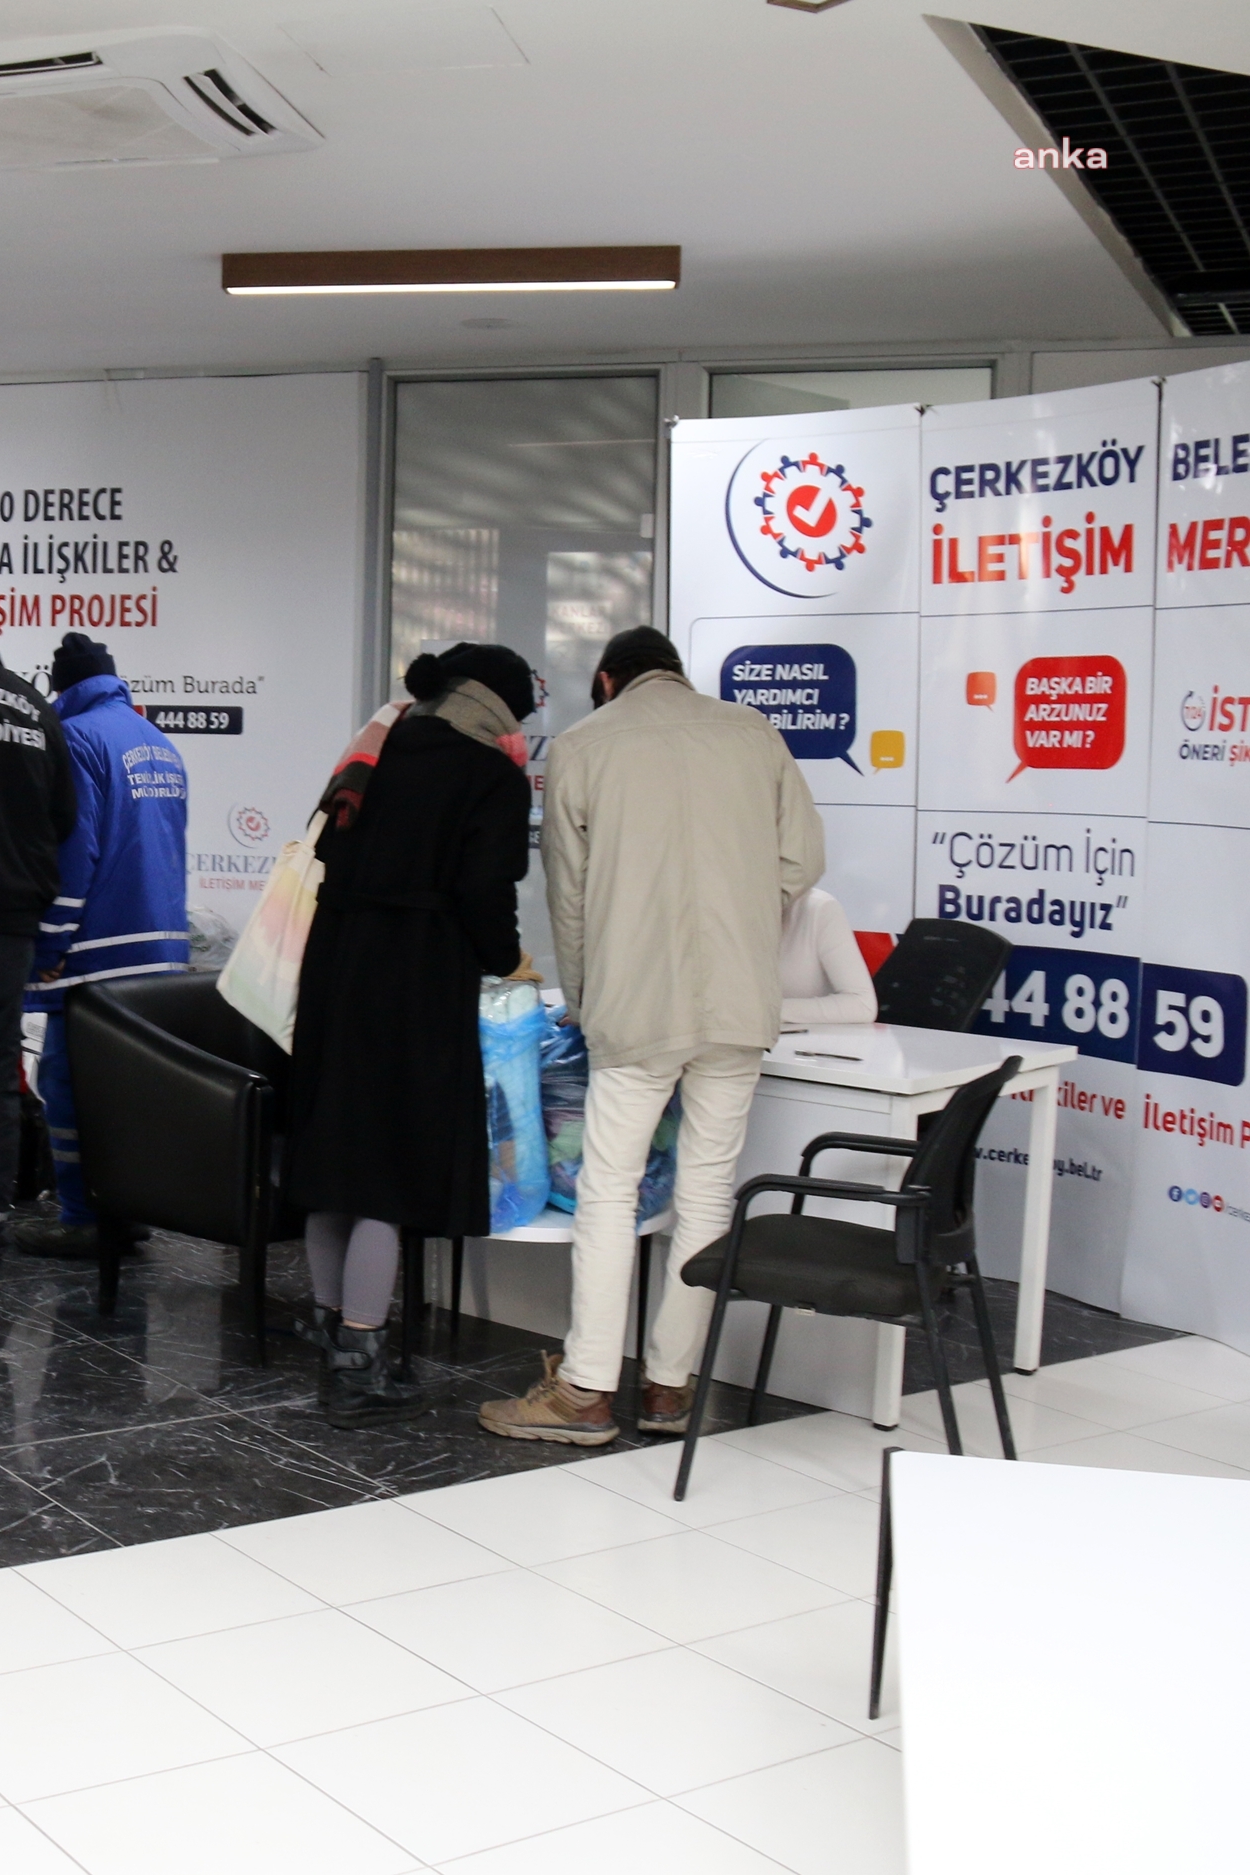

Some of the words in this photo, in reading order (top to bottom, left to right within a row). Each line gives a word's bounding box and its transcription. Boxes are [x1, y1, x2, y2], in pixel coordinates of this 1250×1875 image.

[930, 438, 1146, 513] ÇERKEZKÖY
[1171, 432, 1250, 482] BELE
[23, 487, 122, 522] DERECE
[23, 533, 149, 584] İLİŞKİLER
[157, 539, 178, 573] &
[931, 511, 1134, 594] İLETİŞİM
[1166, 515, 1250, 574] MER
[50, 585, 158, 627] PROJESİ
[731, 660, 774, 681] SİZE
[775, 663, 829, 681] NASIL
[1025, 677, 1084, 700] BAŞKA
[1085, 671, 1113, 695] BİR
[733, 688, 819, 706] YARDIMCI
[1024, 703, 1108, 722] ARZUNUZ
[1208, 684, 1250, 732] İST
[155, 711, 185, 729] 444
[186, 712, 207, 730] 88
[209, 712, 230, 729] 59
[769, 709, 836, 730] BİLİRİM
[1025, 730, 1061, 748] VAR
[1062, 730, 1083, 748] MI
[1179, 739, 1227, 761] ÖNERİ
[1084, 828, 1135, 886] İçin
[248, 880, 266, 891] ME
[981, 969, 1049, 1028] 44
[1061, 973, 1130, 1039] 88
[1153, 989, 1225, 1058] 59
[1102, 1094, 1126, 1120] ve
[1143, 1093, 1234, 1147] İletişim
